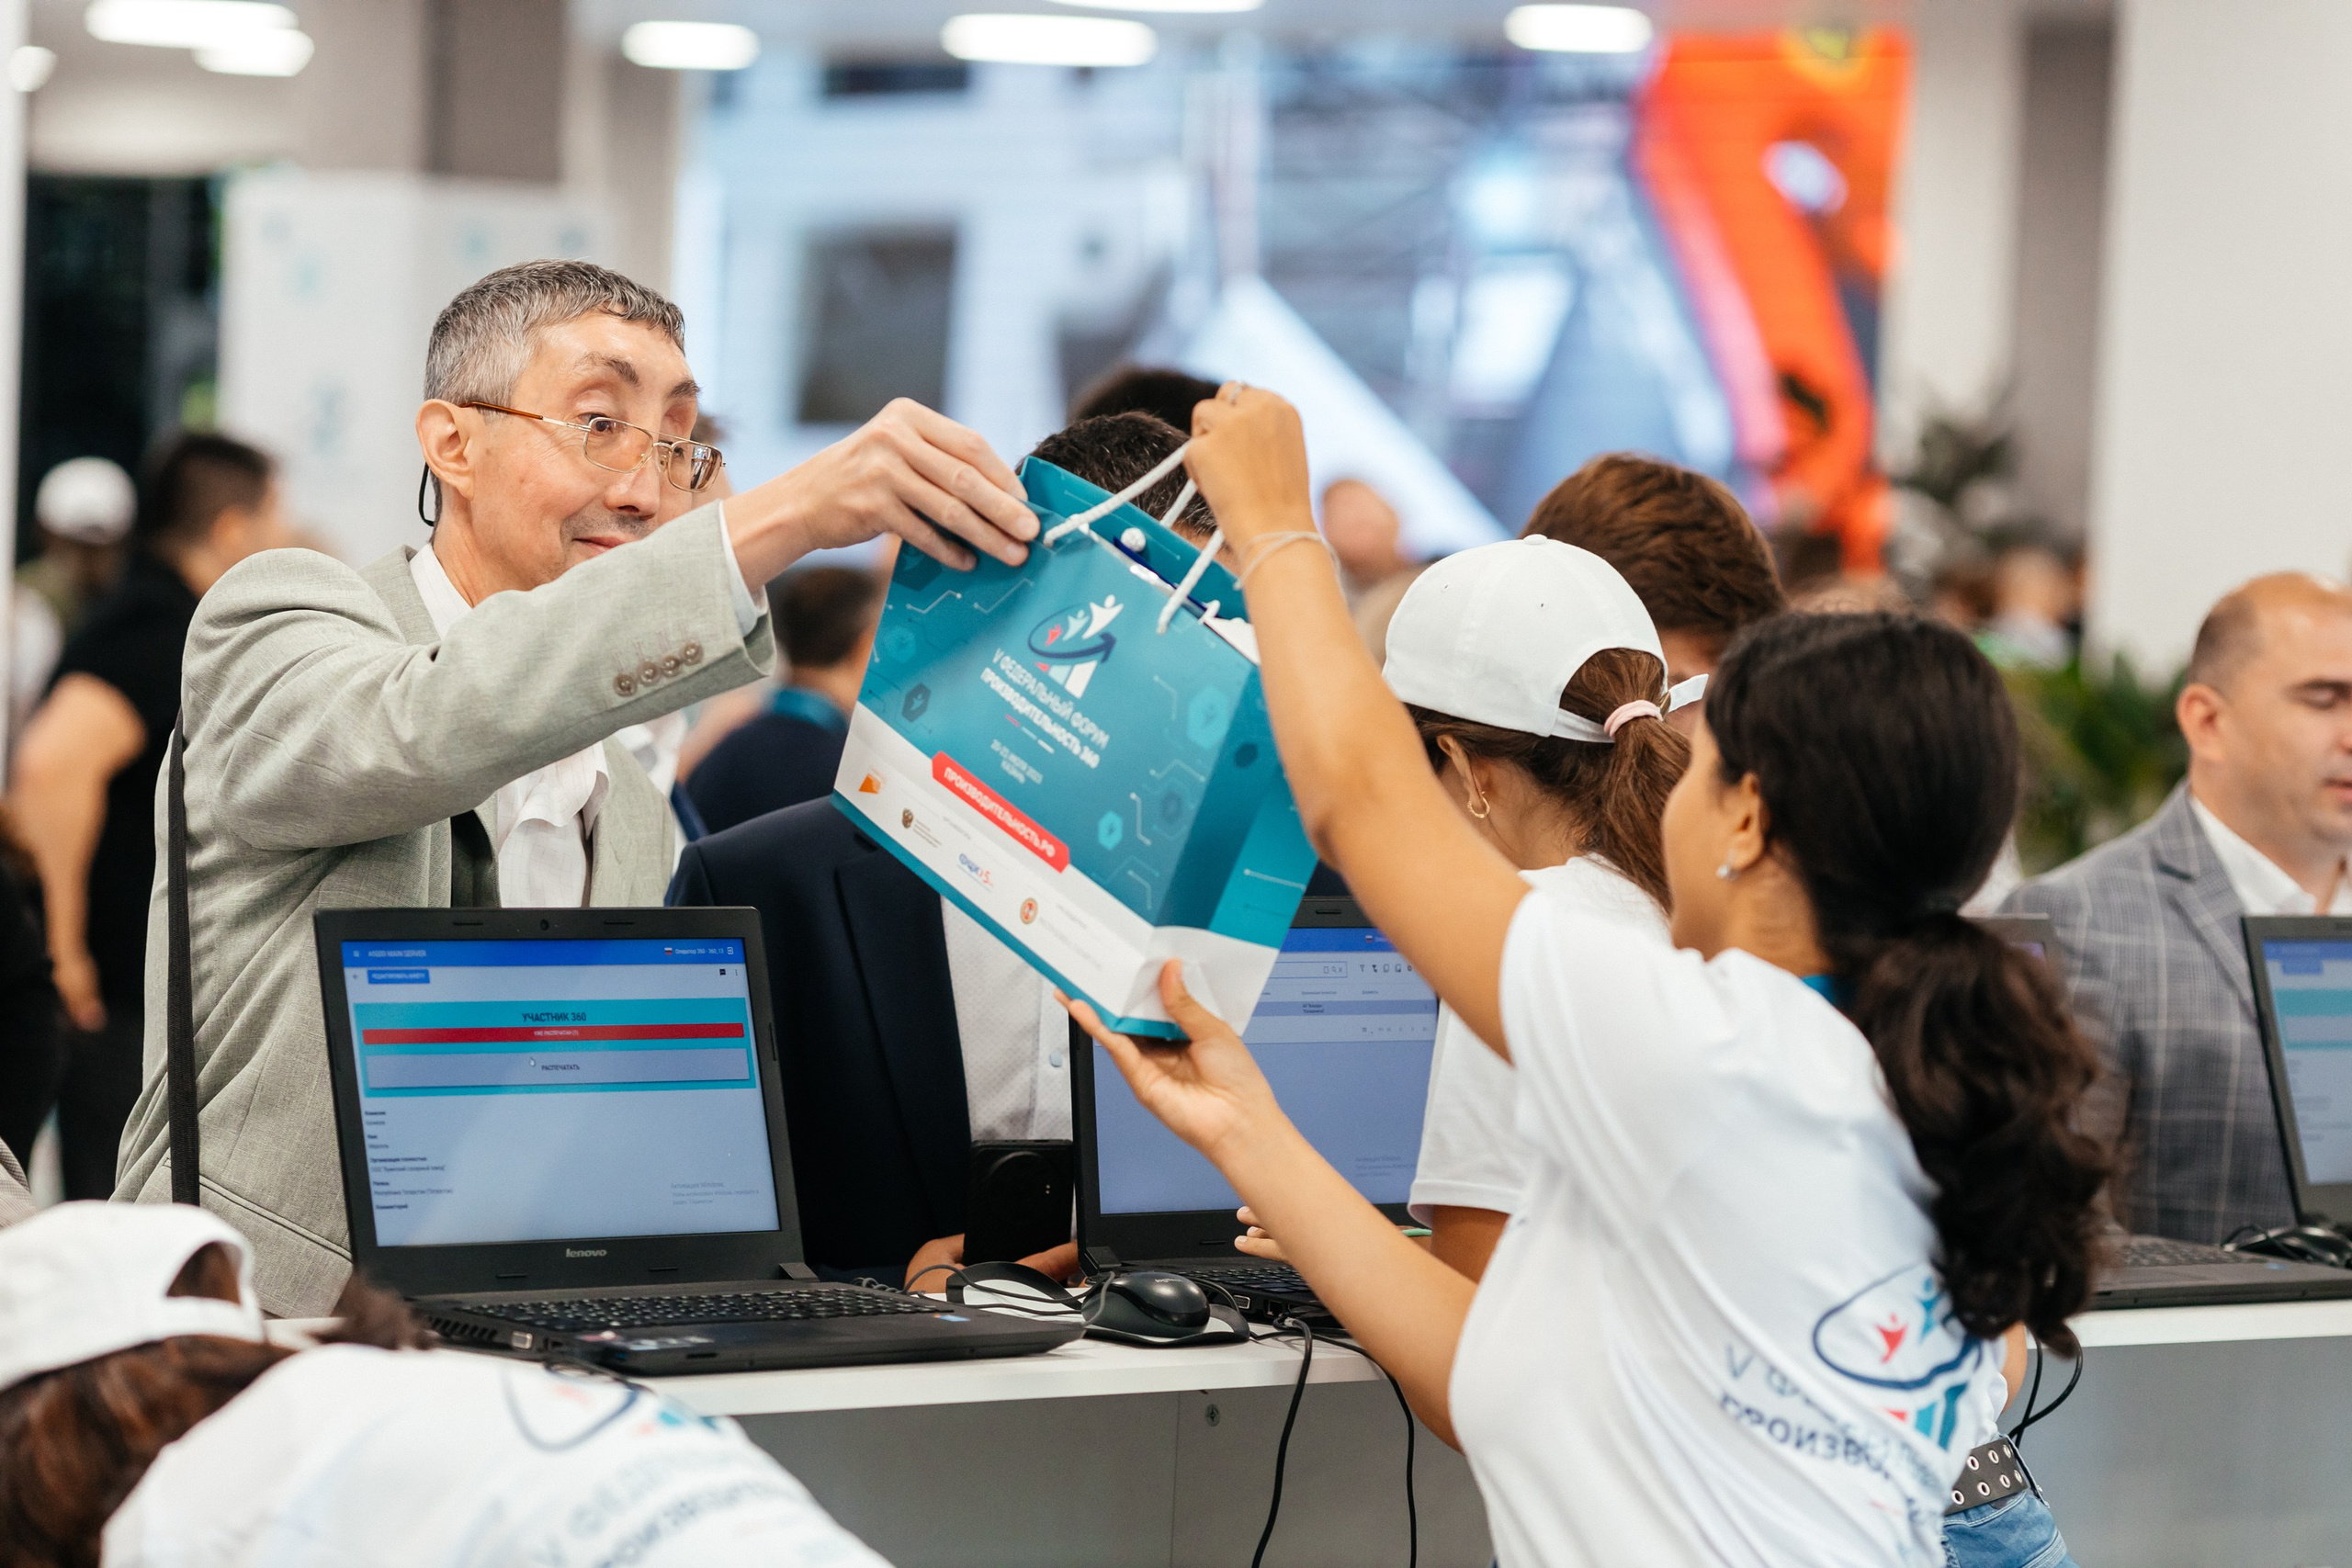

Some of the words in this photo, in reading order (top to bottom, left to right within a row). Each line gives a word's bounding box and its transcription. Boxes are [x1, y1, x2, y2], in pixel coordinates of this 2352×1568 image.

[980, 667, 1082, 756] ПРОИЗВОДИТЕЛЬНОСТЬ
[993, 648, 1004, 664] V
[1000, 655, 1074, 721] ФЕДЕРАЛЬНЫЙ
[1070, 711, 1110, 750] ФОРУМ
[944, 767, 1057, 858] ПРОИЗВОДИТЕЛЬНОСТЬ.РФ
[522, 1012, 570, 1022] УЧАСТНИК
[571, 1011, 587, 1021] 360
